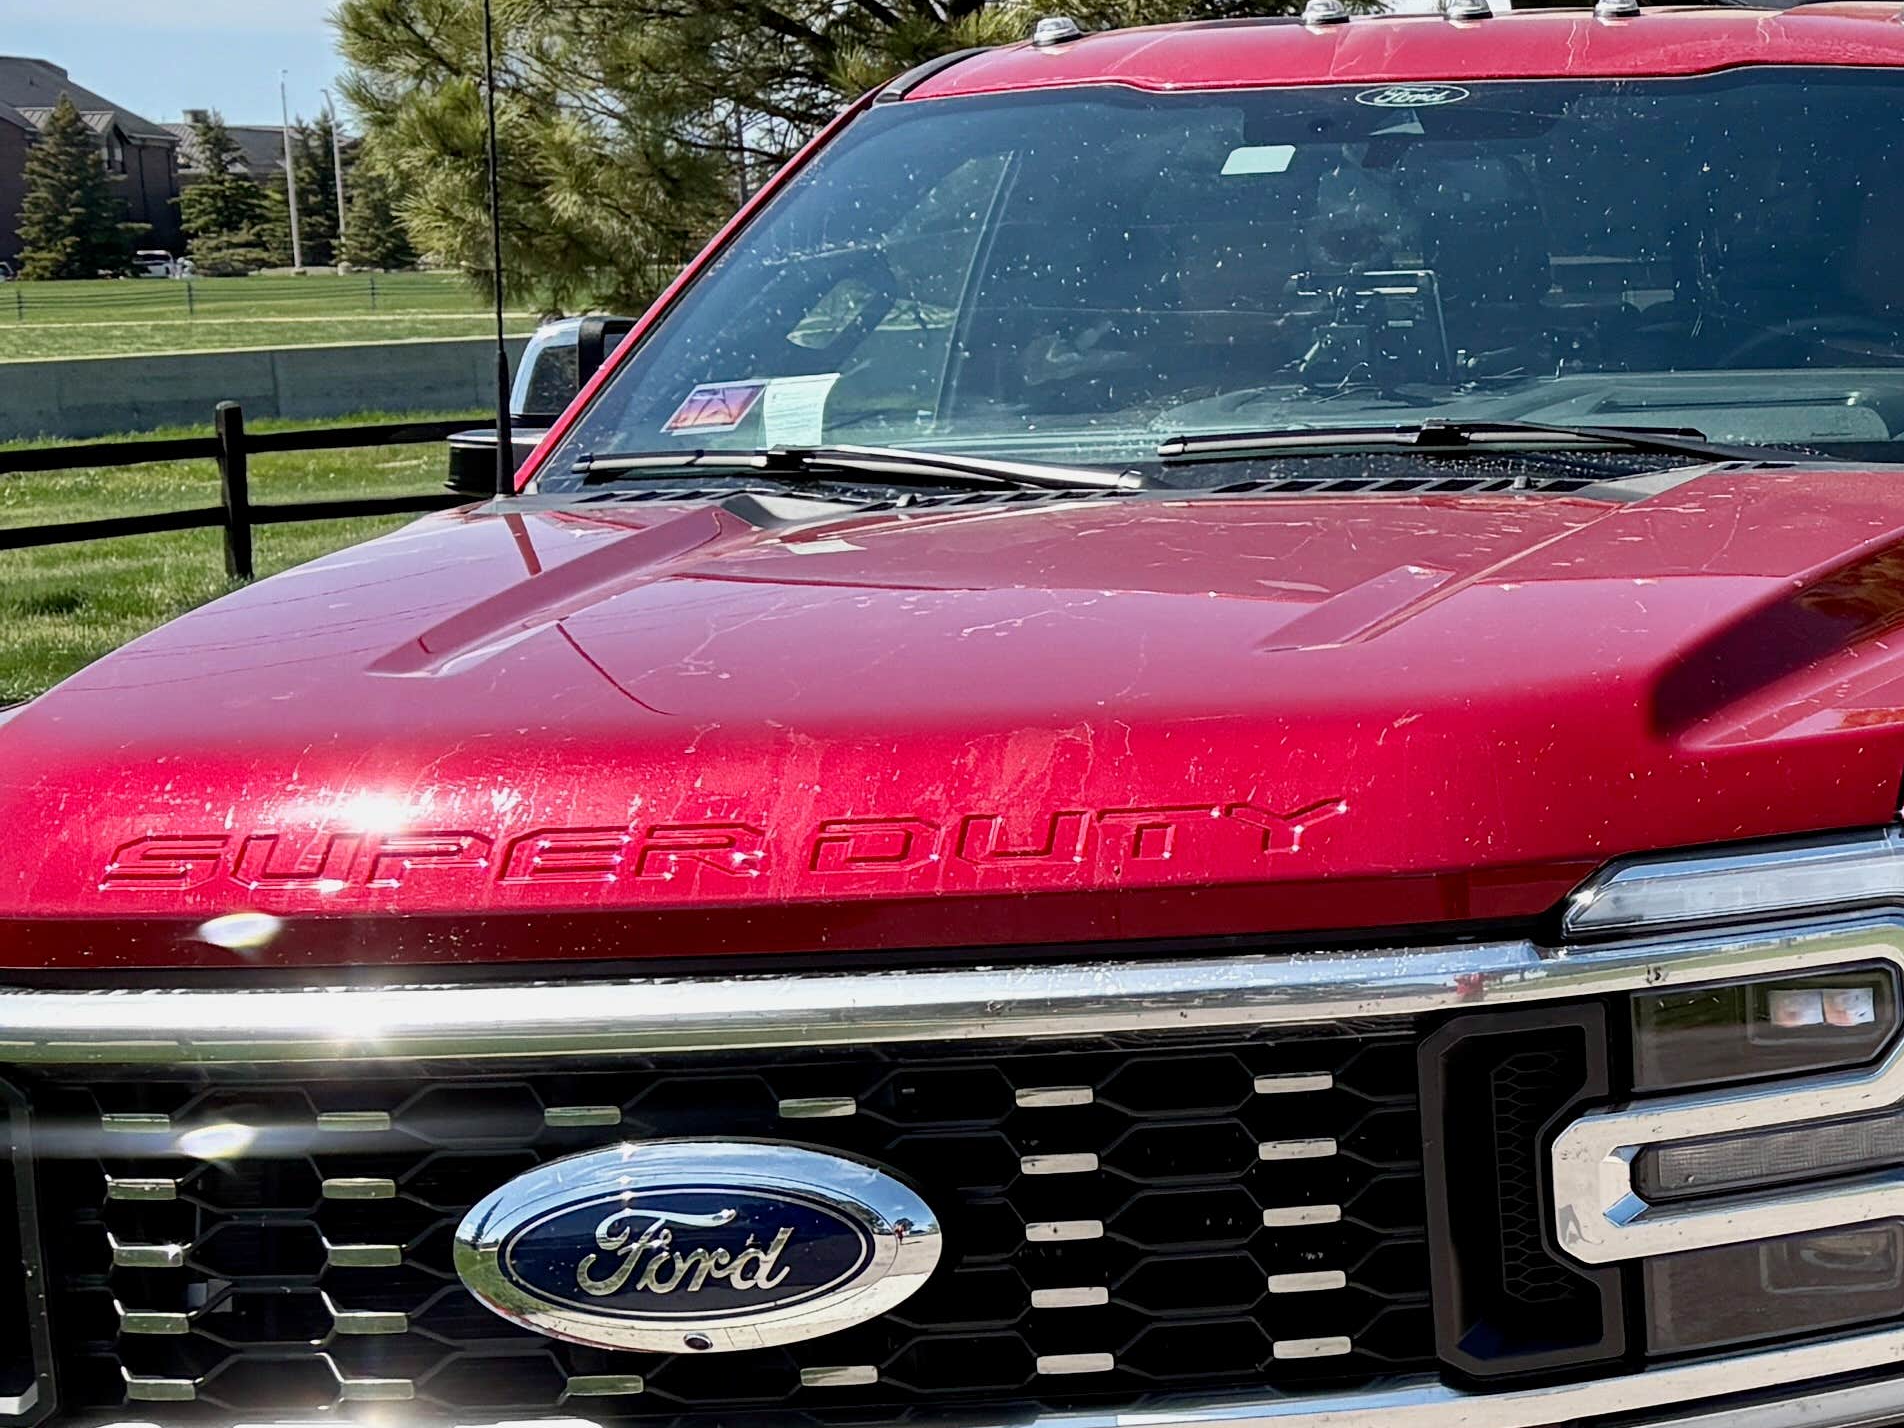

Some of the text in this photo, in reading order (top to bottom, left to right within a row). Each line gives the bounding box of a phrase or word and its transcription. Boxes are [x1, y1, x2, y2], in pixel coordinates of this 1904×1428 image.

[1373, 86, 1451, 103] Ford
[98, 797, 1348, 891] SUPER DUTY
[576, 1208, 795, 1296] Ford
